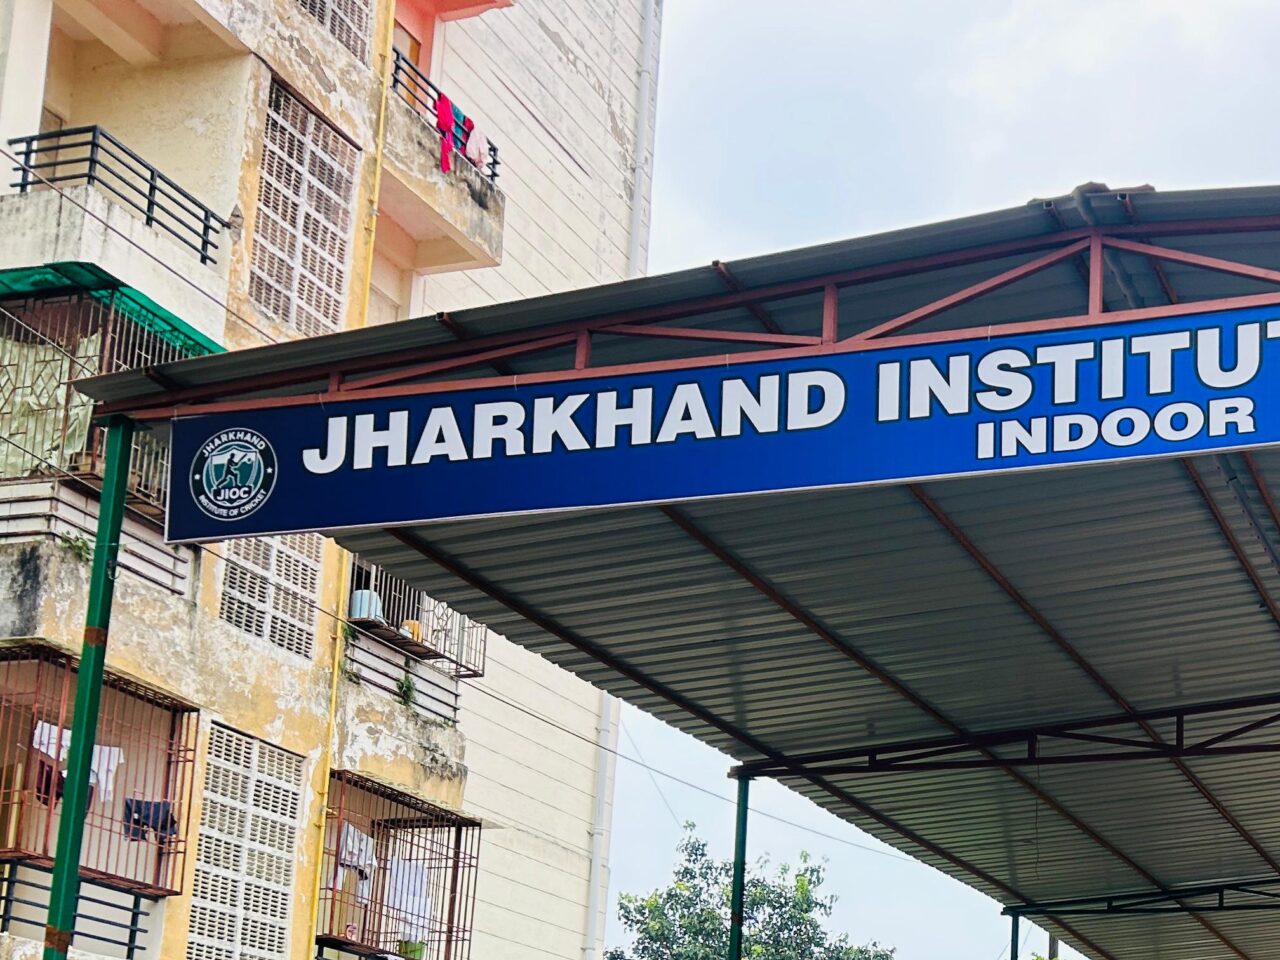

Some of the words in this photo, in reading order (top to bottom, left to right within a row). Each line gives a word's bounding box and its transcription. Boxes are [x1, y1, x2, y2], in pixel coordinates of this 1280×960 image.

[302, 370, 847, 474] JHARKHAND
[976, 397, 1256, 460] INDOOR
[202, 431, 266, 457] JHARKHAND
[199, 495, 228, 516] INSTITUTE
[228, 508, 239, 516] OF
[240, 488, 267, 513] CRICKET
[216, 487, 249, 501] JIOC
